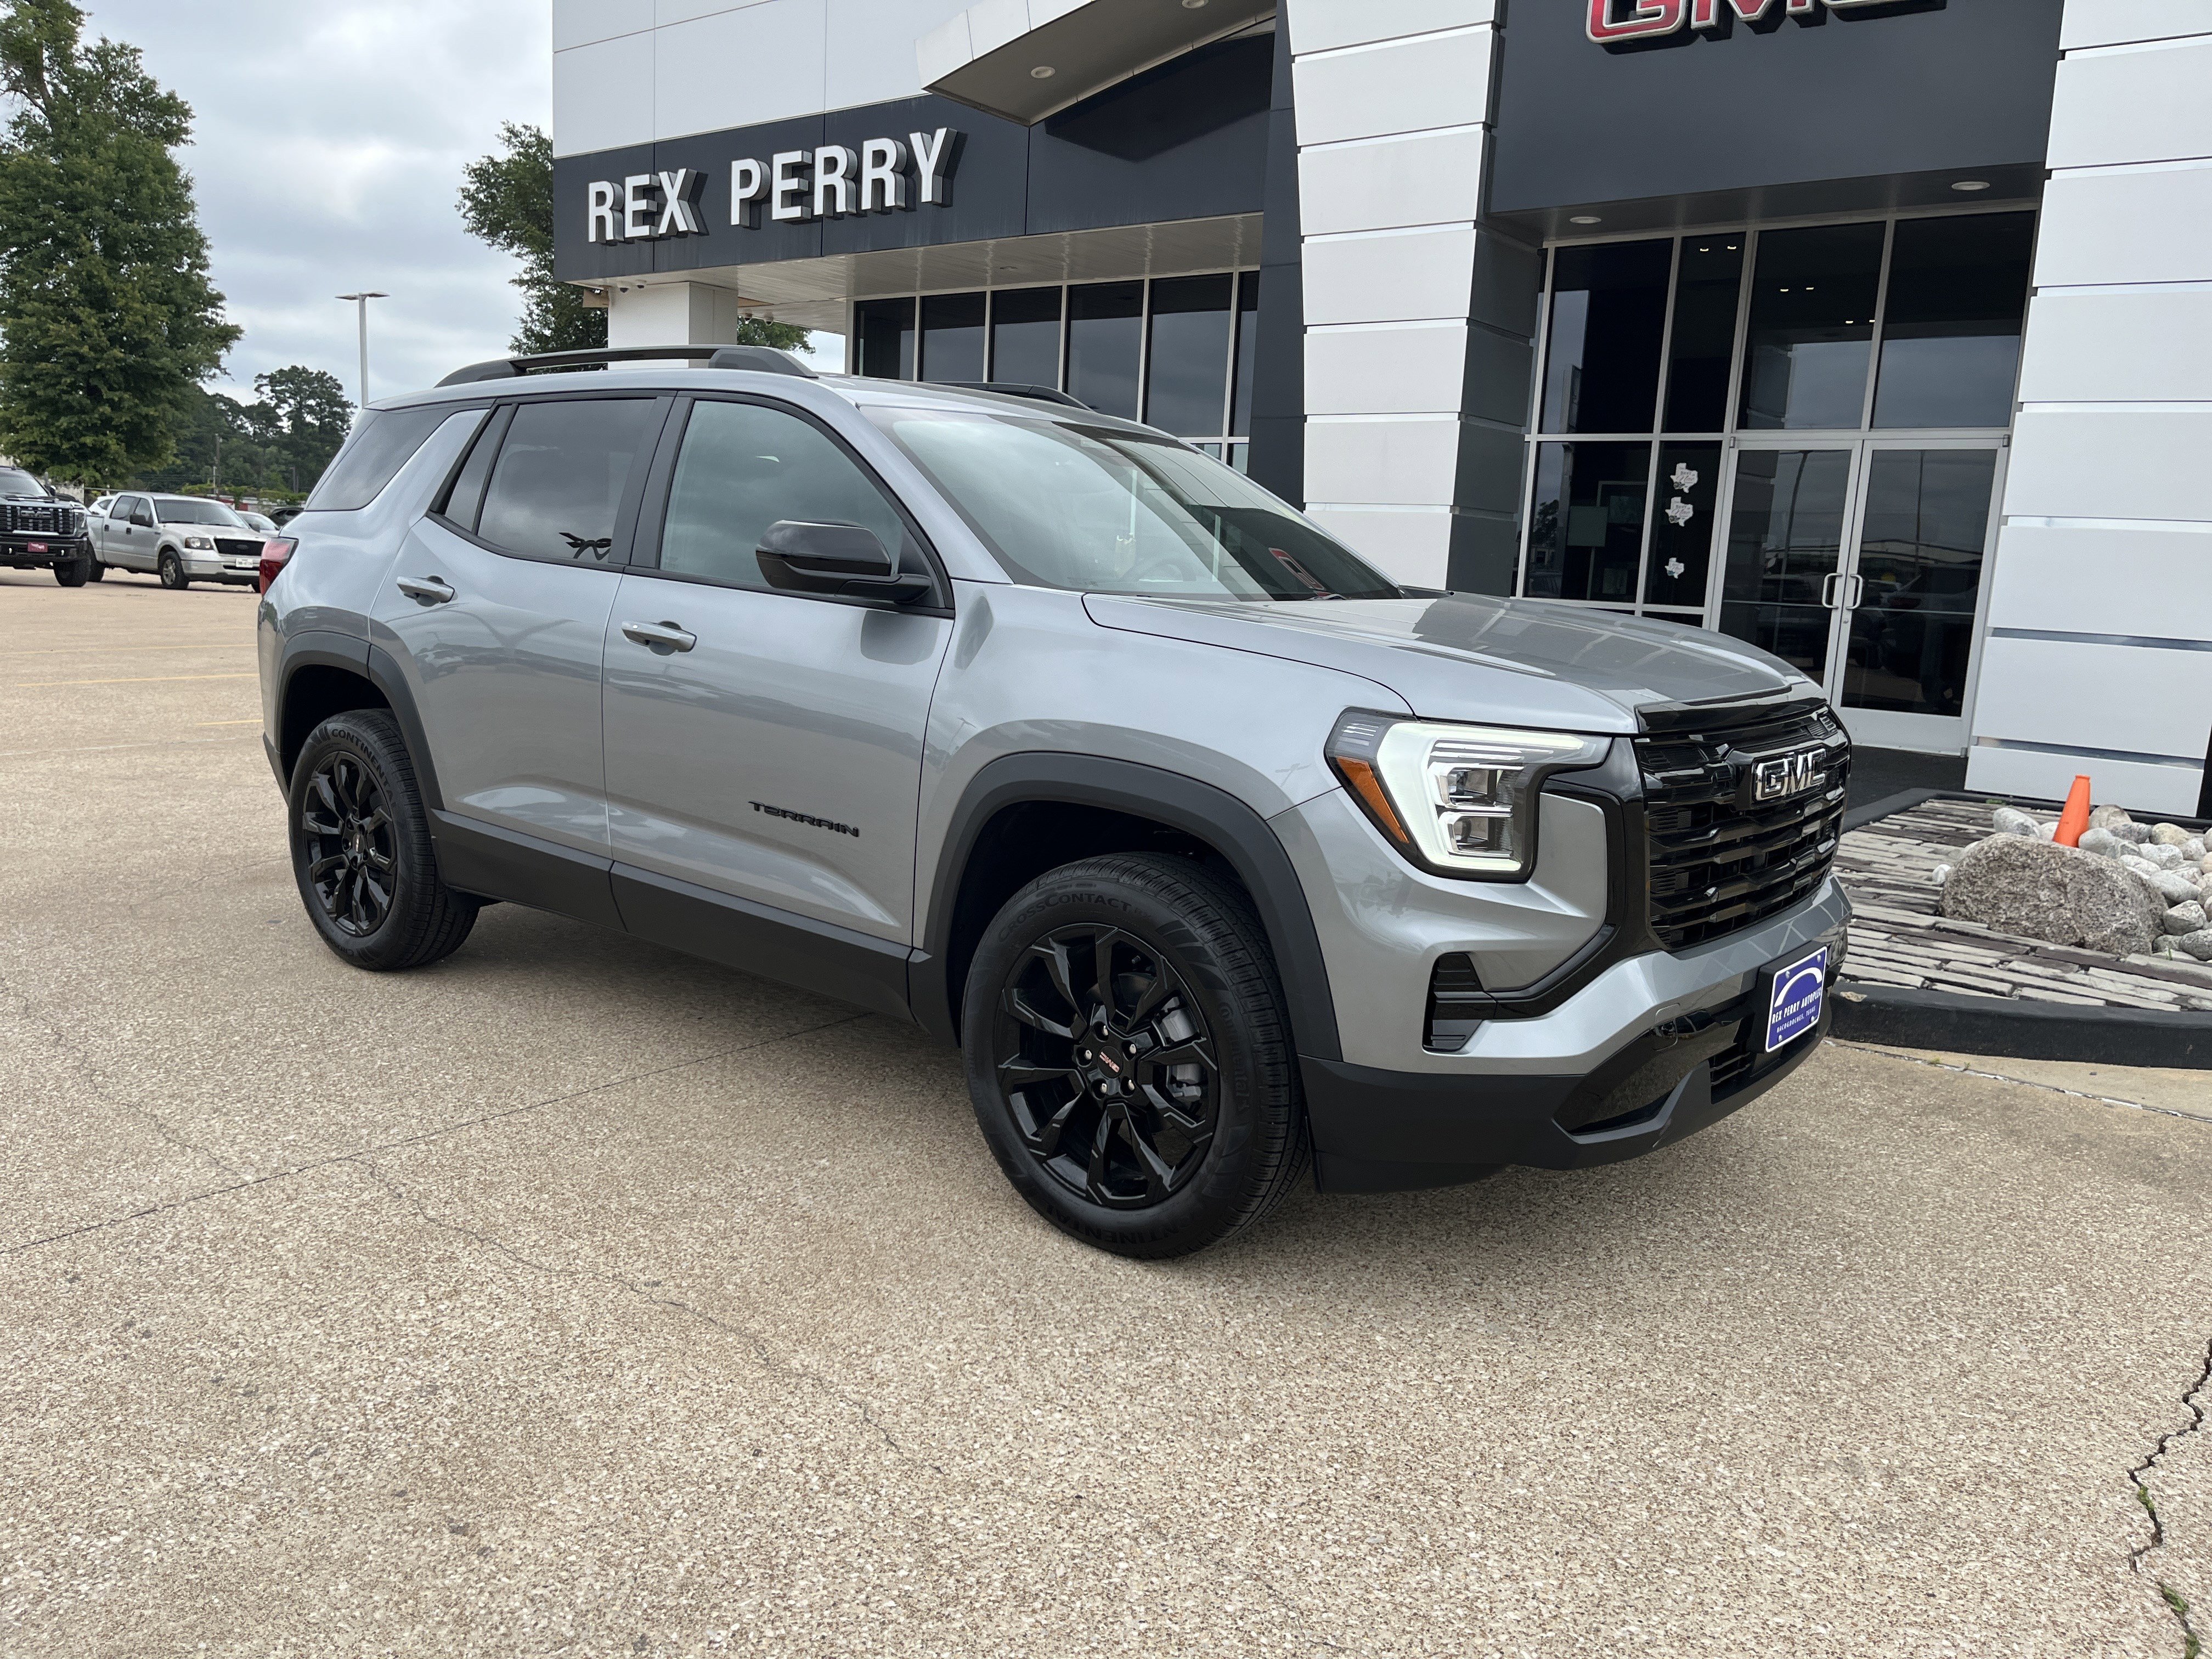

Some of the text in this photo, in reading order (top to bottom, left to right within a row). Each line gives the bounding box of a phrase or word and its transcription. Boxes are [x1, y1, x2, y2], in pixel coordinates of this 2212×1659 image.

[589, 127, 958, 244] REX PERRY
[1756, 748, 1826, 801] GMC
[748, 800, 859, 837] TERRAIN
[1771, 986, 1821, 1024] REX PERRY AUTOPLEX
[1805, 1005, 1816, 1017] TEXAS
[1099, 1051, 1120, 1073] GMC
